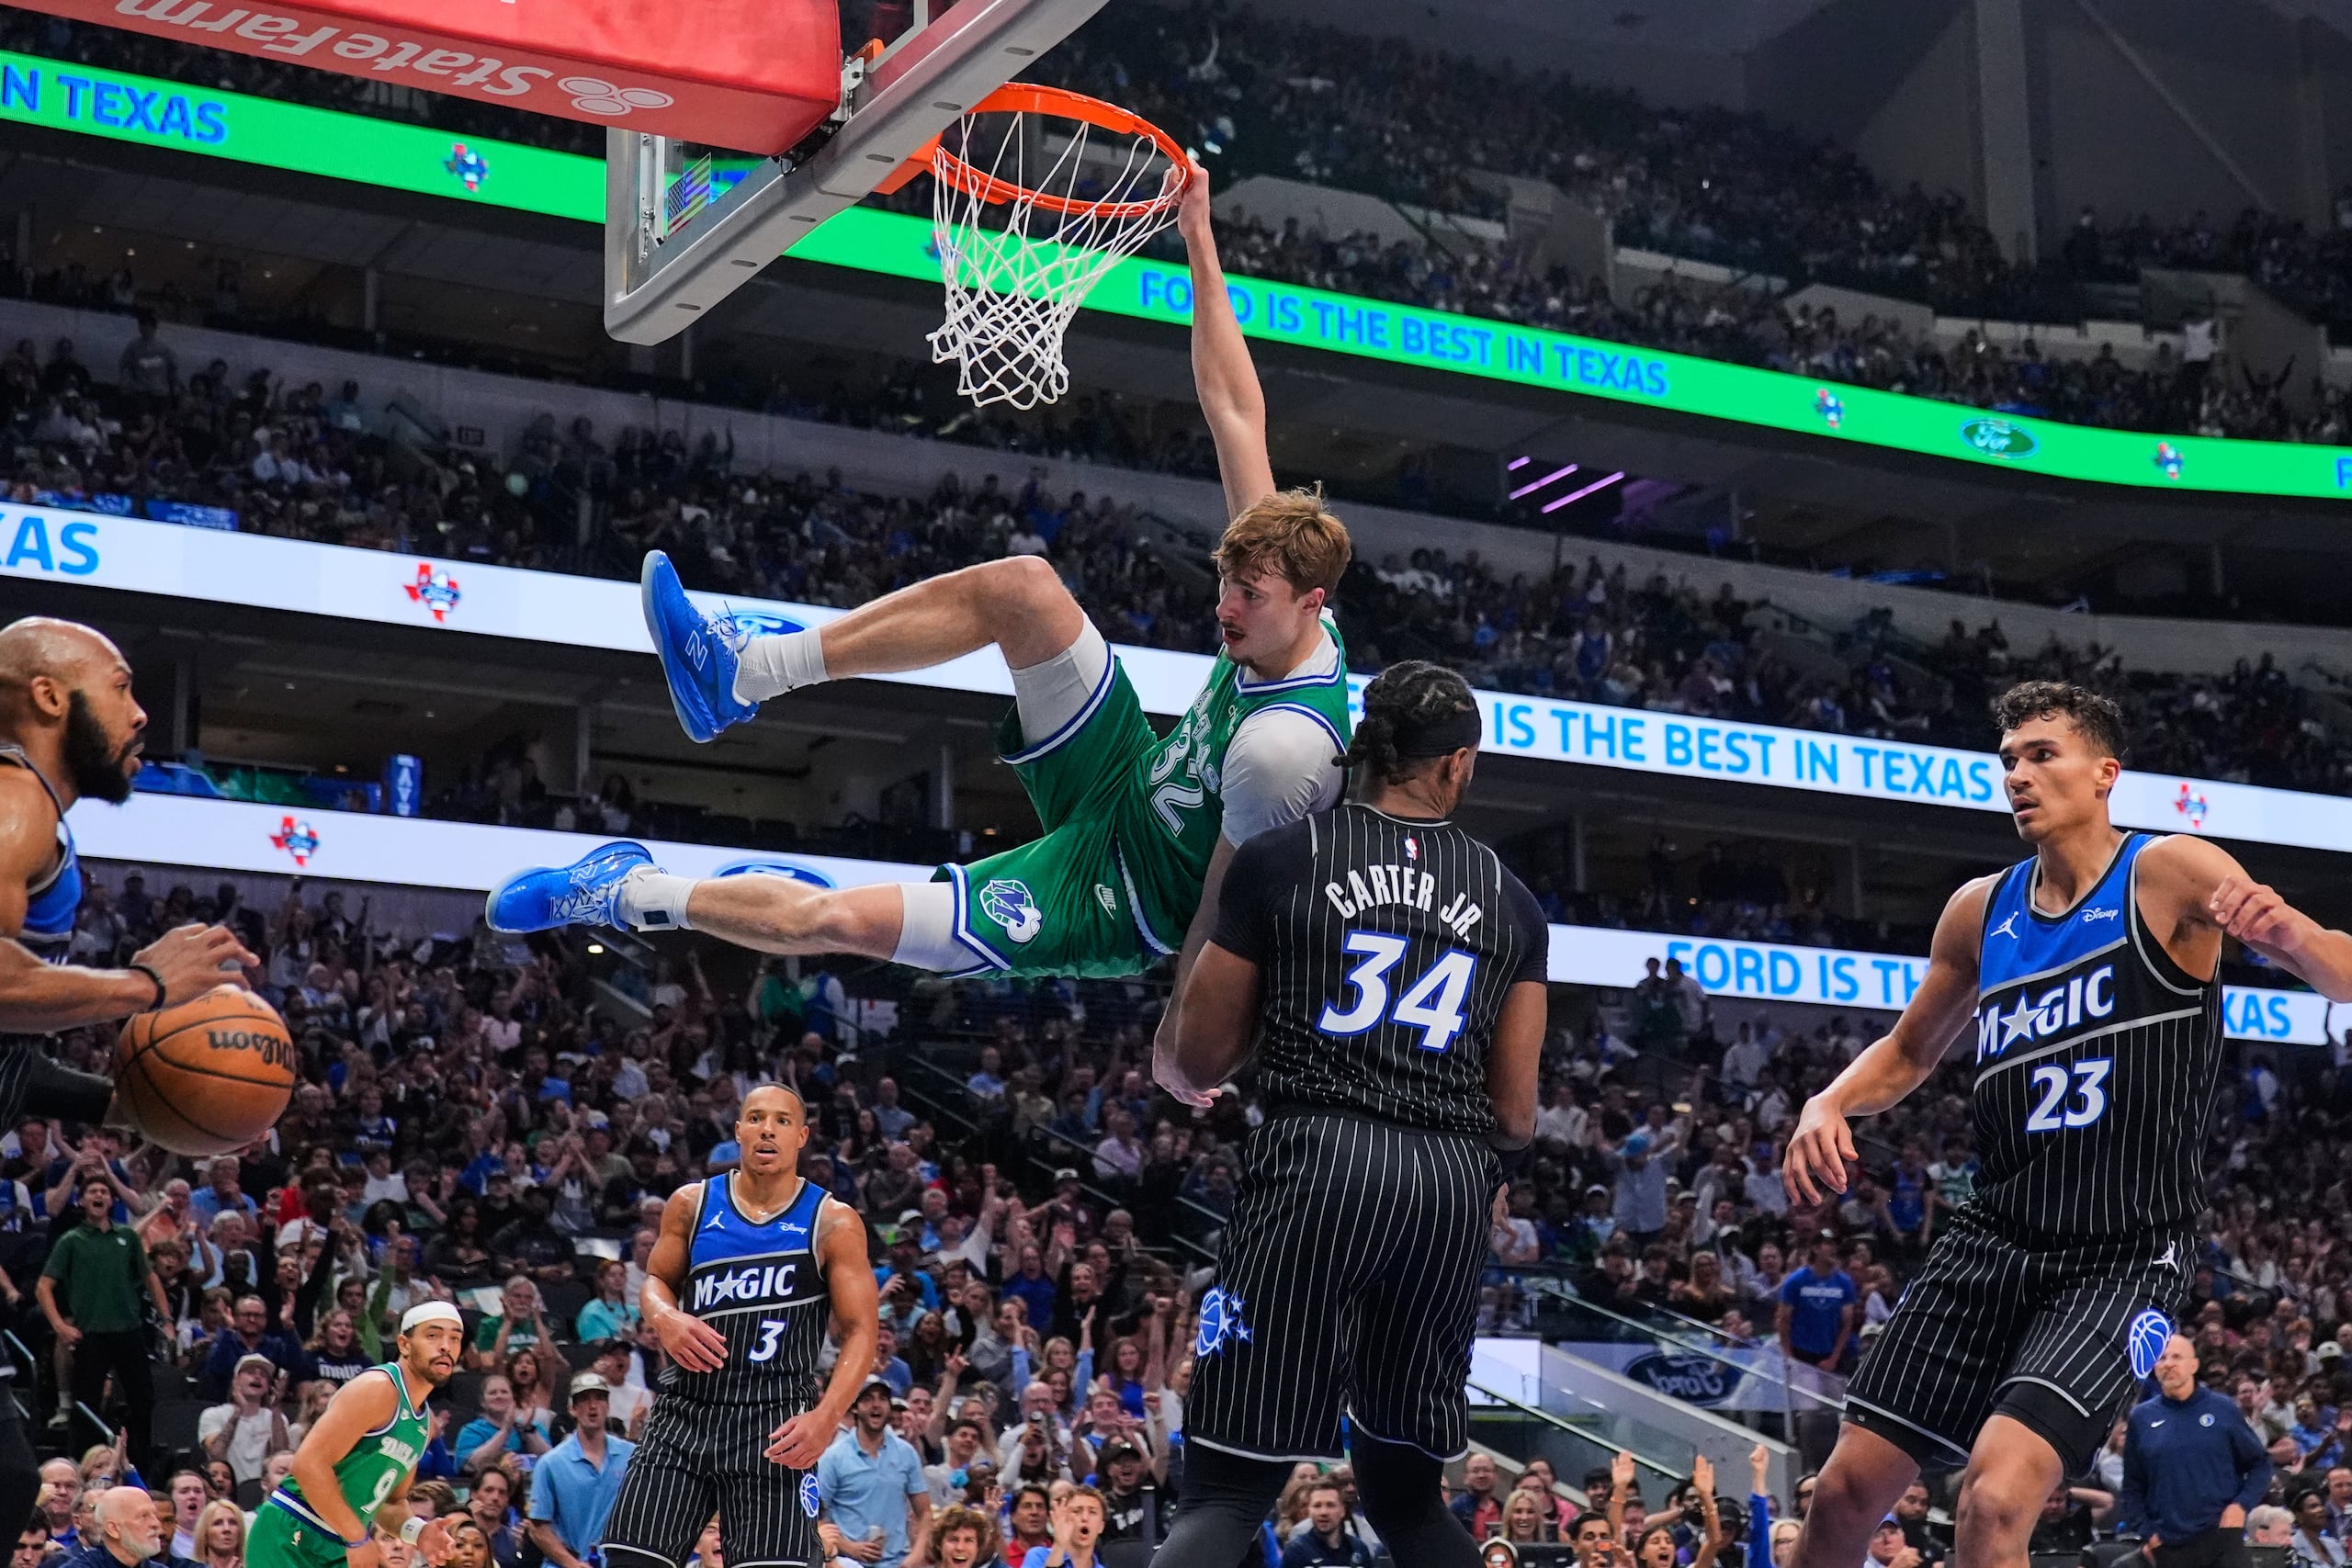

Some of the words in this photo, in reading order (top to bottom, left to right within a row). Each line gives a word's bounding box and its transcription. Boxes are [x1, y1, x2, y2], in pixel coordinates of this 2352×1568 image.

[3, 65, 40, 111] N
[57, 73, 227, 144] TEXAS
[1141, 271, 1253, 324] FOD
[1268, 293, 1304, 333] IS
[1312, 300, 1389, 348] THE
[1402, 316, 1493, 362] BEST
[1506, 335, 1543, 375] IN
[1553, 344, 1668, 397] TEXAS
[1494, 703, 1535, 748] IS
[1551, 709, 1645, 762] THE
[1664, 724, 1776, 776] BEST
[1794, 739, 1838, 784] IN
[1853, 746, 1992, 802] TEXAS
[1102, 887, 1117, 910] NIKE
[1325, 864, 1435, 919] CARTER
[1441, 892, 1482, 942] JR.
[2081, 907, 2119, 922] Disney
[1316, 929, 1478, 1054] 34
[1668, 942, 1802, 995] FORD
[1819, 955, 1859, 1001] IS
[1871, 960, 1928, 1004] TH
[2222, 992, 2291, 1037] XAS
[2025, 1056, 2115, 1133] 23
[779, 1222, 808, 1235] Disney
[748, 1319, 788, 1362] 3
[359, 1468, 398, 1515] 9
